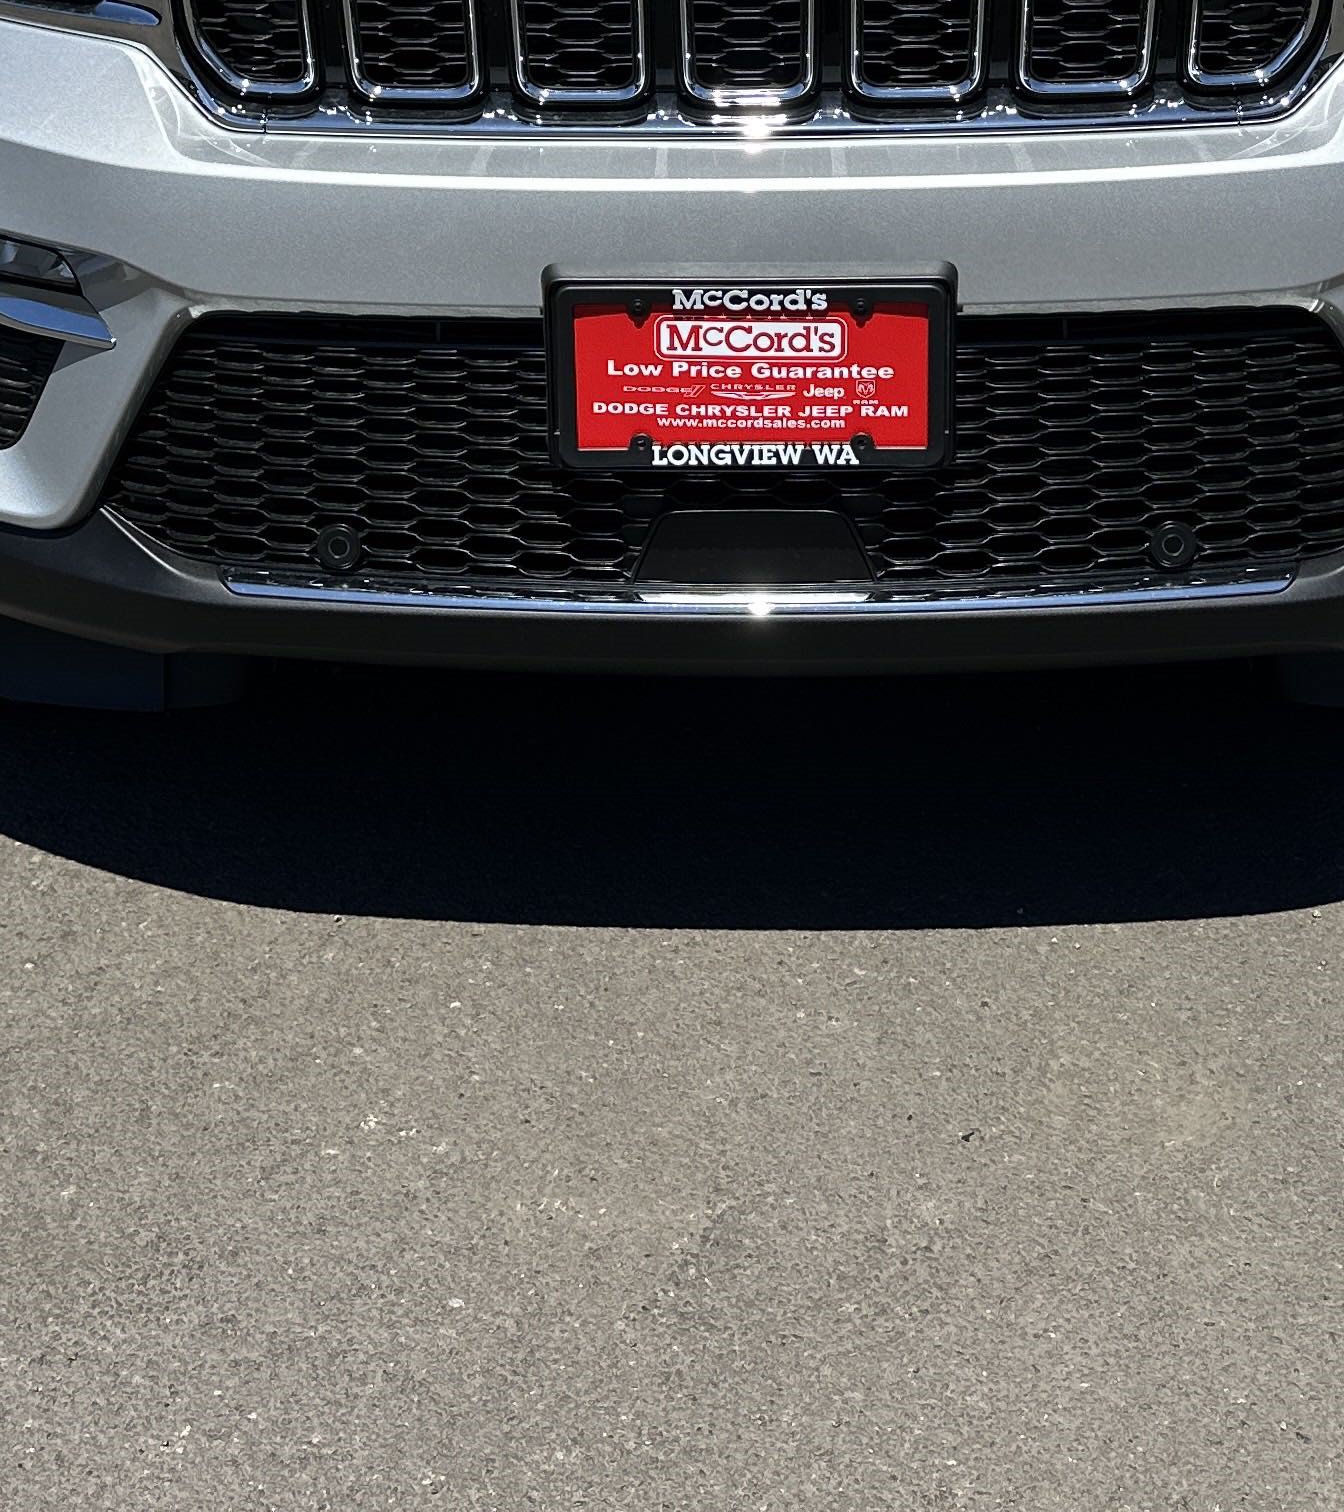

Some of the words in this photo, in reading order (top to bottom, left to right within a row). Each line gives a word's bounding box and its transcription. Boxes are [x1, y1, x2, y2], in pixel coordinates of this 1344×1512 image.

[672, 290, 828, 311] McCord's
[666, 324, 836, 353] McCord's
[607, 360, 664, 376] Low
[672, 361, 743, 378] Price
[751, 362, 895, 379] Guarantee
[710, 383, 796, 391] CHRYSLER
[803, 384, 845, 400] Jeep
[592, 402, 669, 415] DODGE
[675, 403, 792, 417] CHRYSLER
[798, 405, 854, 417] JEEP
[860, 405, 909, 418] RAM
[657, 417, 846, 429] www.mccordsales.com
[651, 444, 805, 466] LONGVIEW
[812, 445, 859, 465] WA
